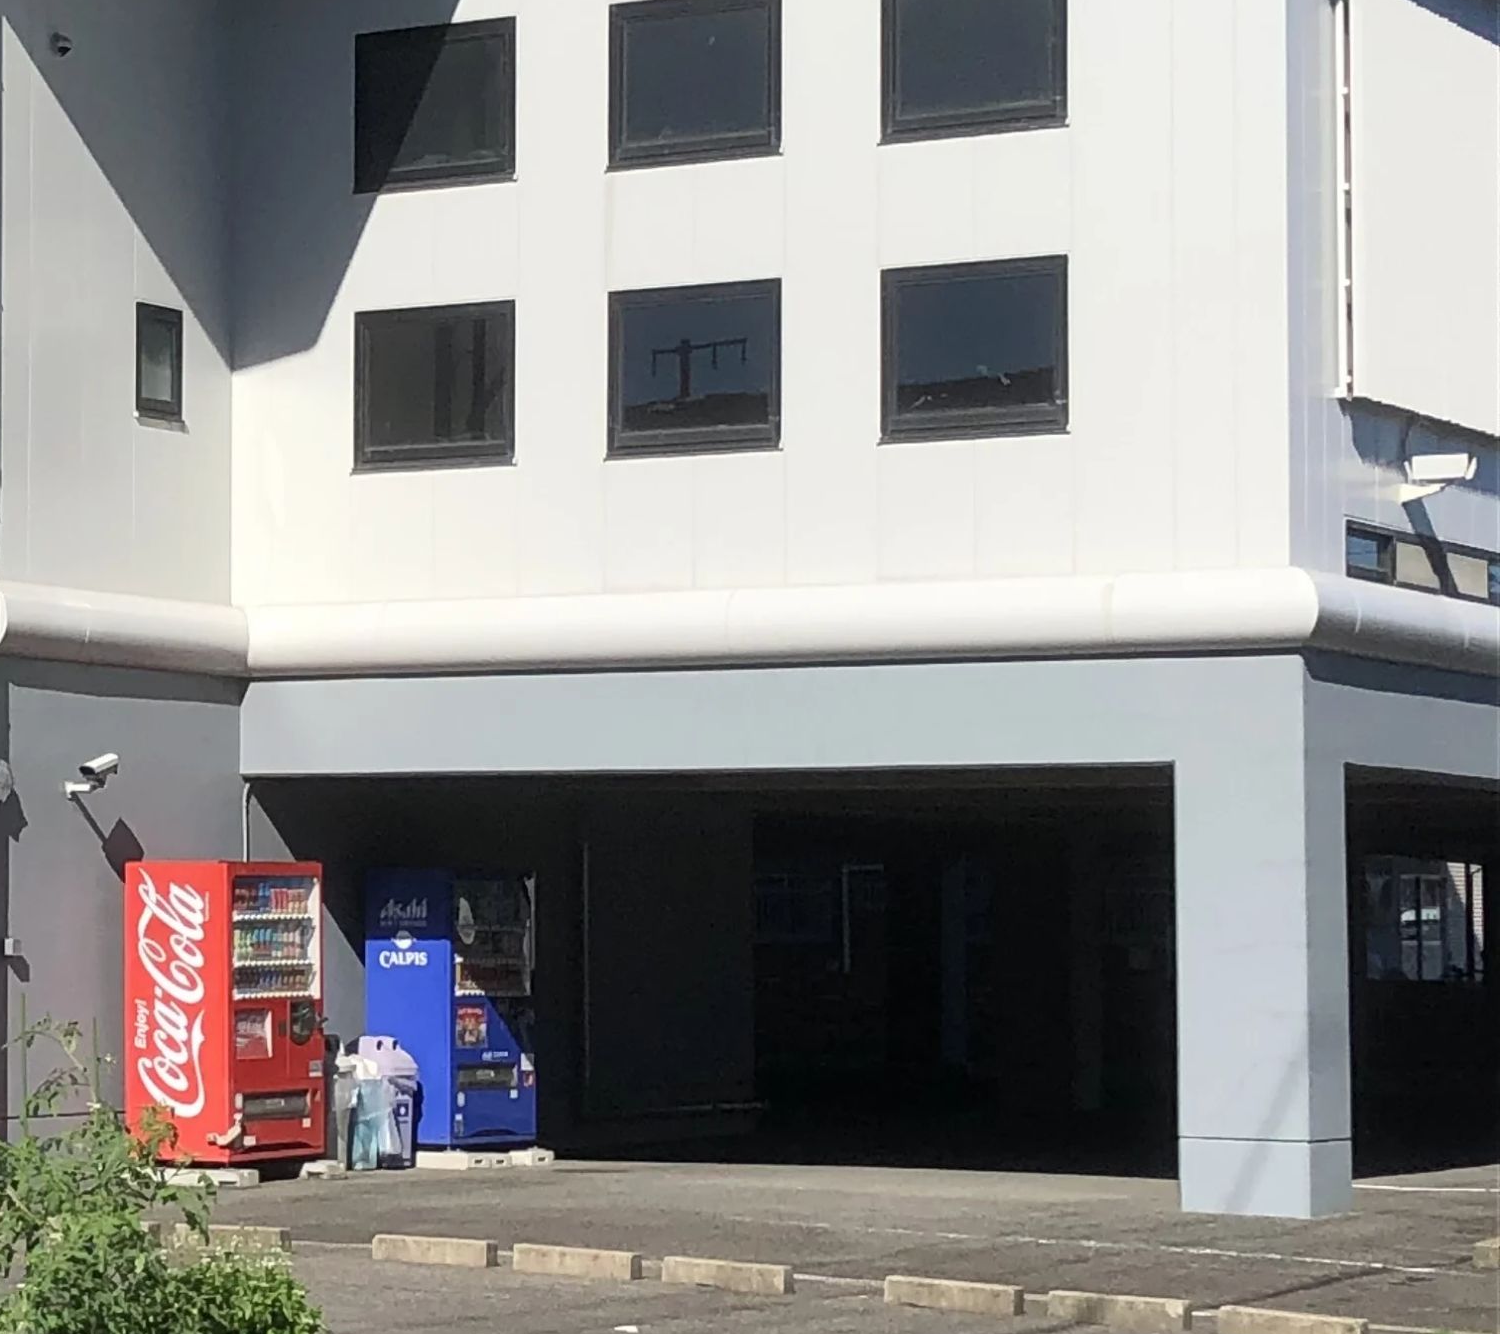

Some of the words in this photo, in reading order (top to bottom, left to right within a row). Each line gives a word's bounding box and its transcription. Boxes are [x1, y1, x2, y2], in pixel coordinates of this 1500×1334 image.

[379, 897, 428, 919] Asahi
[378, 950, 429, 969] CALPIS
[137, 866, 206, 1119] Coca-Cola
[133, 998, 150, 1050] Enjoy!
